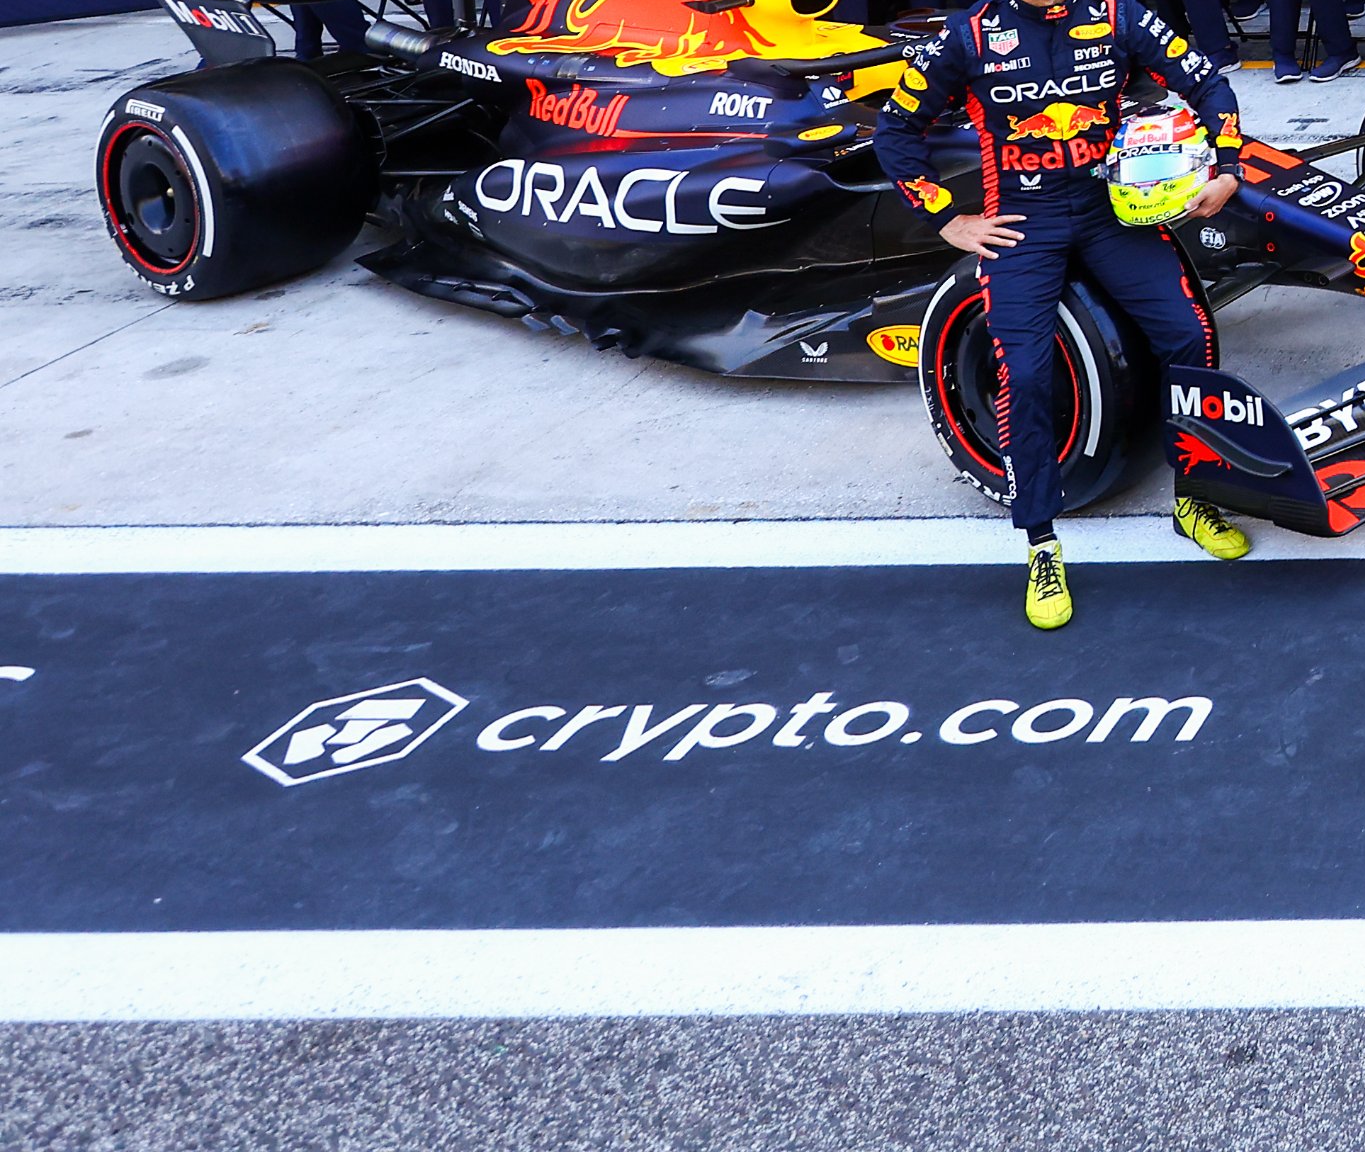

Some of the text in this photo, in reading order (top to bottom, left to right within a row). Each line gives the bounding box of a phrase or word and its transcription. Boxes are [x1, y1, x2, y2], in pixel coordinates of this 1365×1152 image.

[440, 52, 502, 83] HONDA
[984, 59, 1017, 74] Mobil
[1074, 44, 1112, 61] BYBIT
[990, 69, 1117, 103] ORACLE
[708, 91, 773, 120] ROKT
[1002, 127, 1115, 171] Red Bu
[1118, 144, 1181, 160] ORACLE
[476, 159, 790, 235] ORACLE
[1170, 384, 1263, 427] Mobil
[477, 689, 1213, 762] crypto.com
